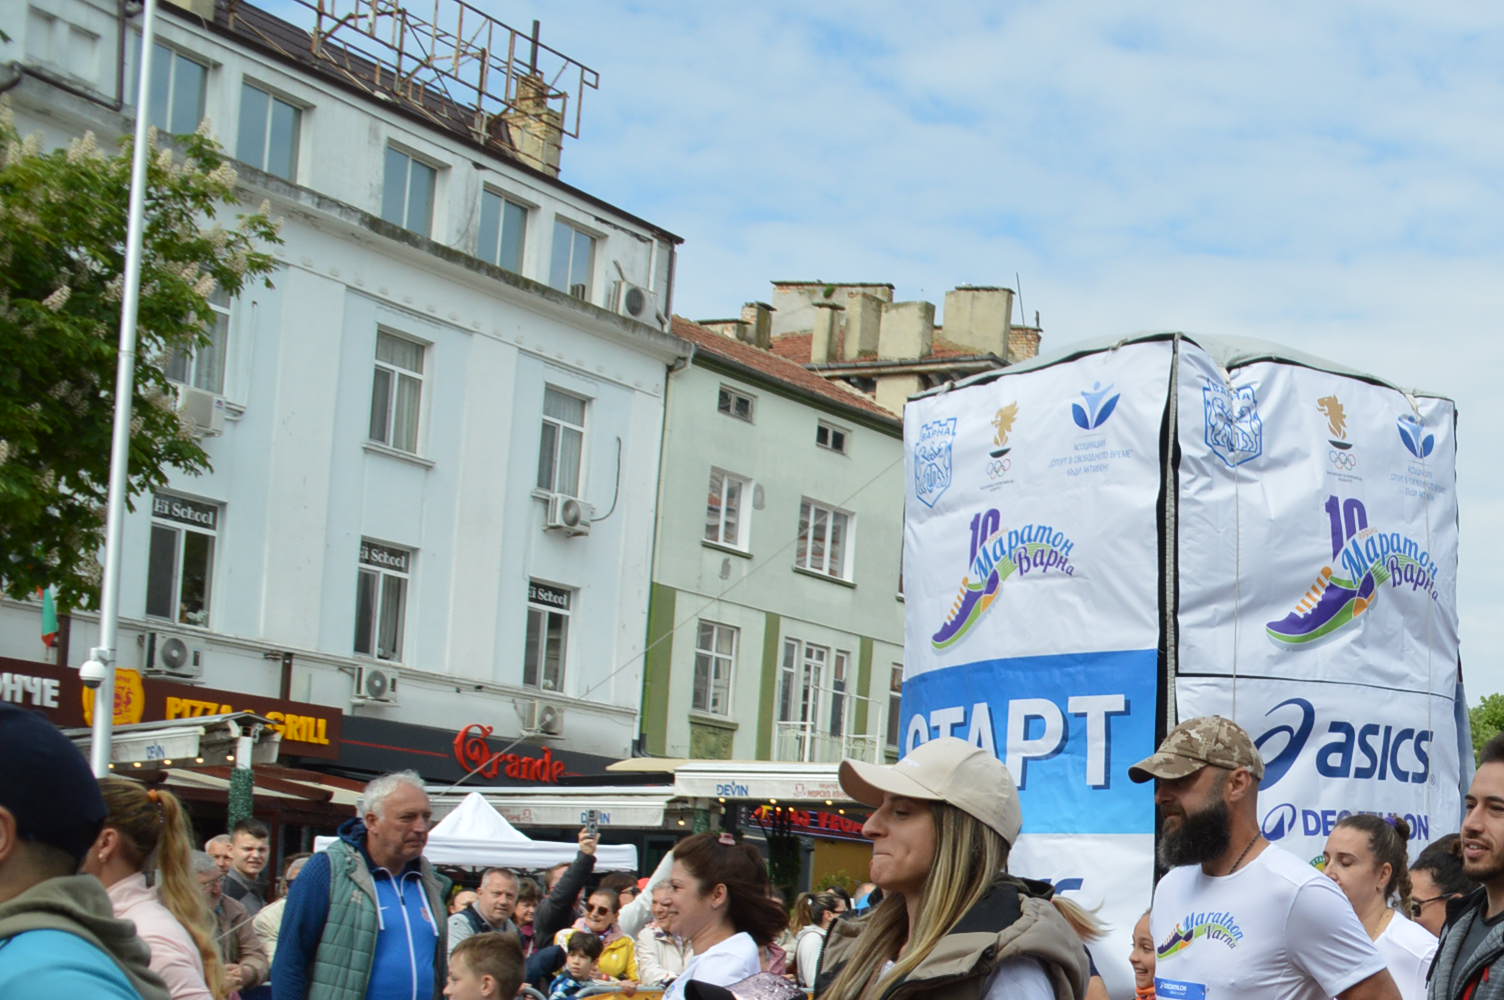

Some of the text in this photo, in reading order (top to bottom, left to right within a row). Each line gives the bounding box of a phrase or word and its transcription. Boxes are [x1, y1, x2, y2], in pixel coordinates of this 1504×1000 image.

[171, 502, 214, 525] School
[1325, 494, 1368, 562] 10
[969, 508, 1000, 571] 10
[973, 523, 1075, 585] Маратон
[370, 548, 406, 569] School
[1012, 545, 1076, 577] Варна
[1341, 531, 1439, 586] Маратон
[1386, 553, 1440, 601] Варна
[537, 588, 568, 607] School
[453, 723, 566, 784] Grande
[716, 780, 749, 797] DEVIN
[1183, 911, 1244, 941] Marathon
[1204, 924, 1237, 950] Varna
